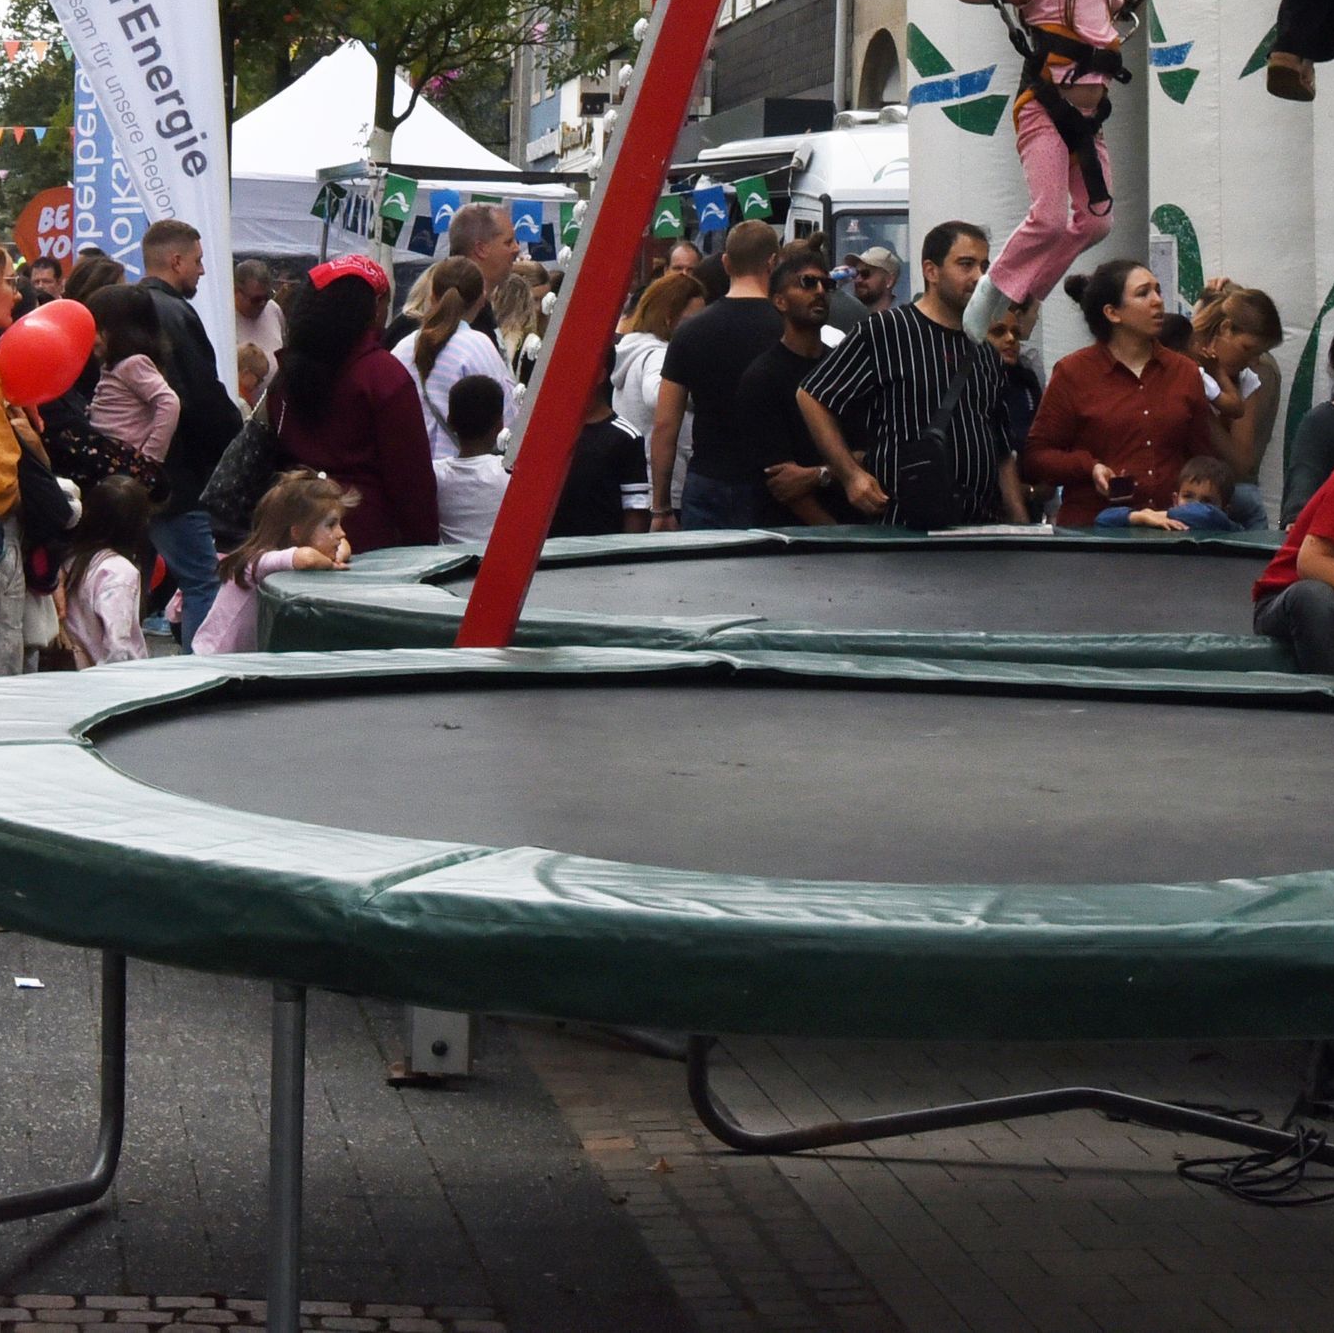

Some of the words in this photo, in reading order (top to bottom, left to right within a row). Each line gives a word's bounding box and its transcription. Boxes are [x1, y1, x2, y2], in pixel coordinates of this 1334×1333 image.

[90, 41, 113, 68] für
[105, 74, 144, 144] unsere
[138, 147, 176, 218] Region
[38, 203, 70, 234] BE
